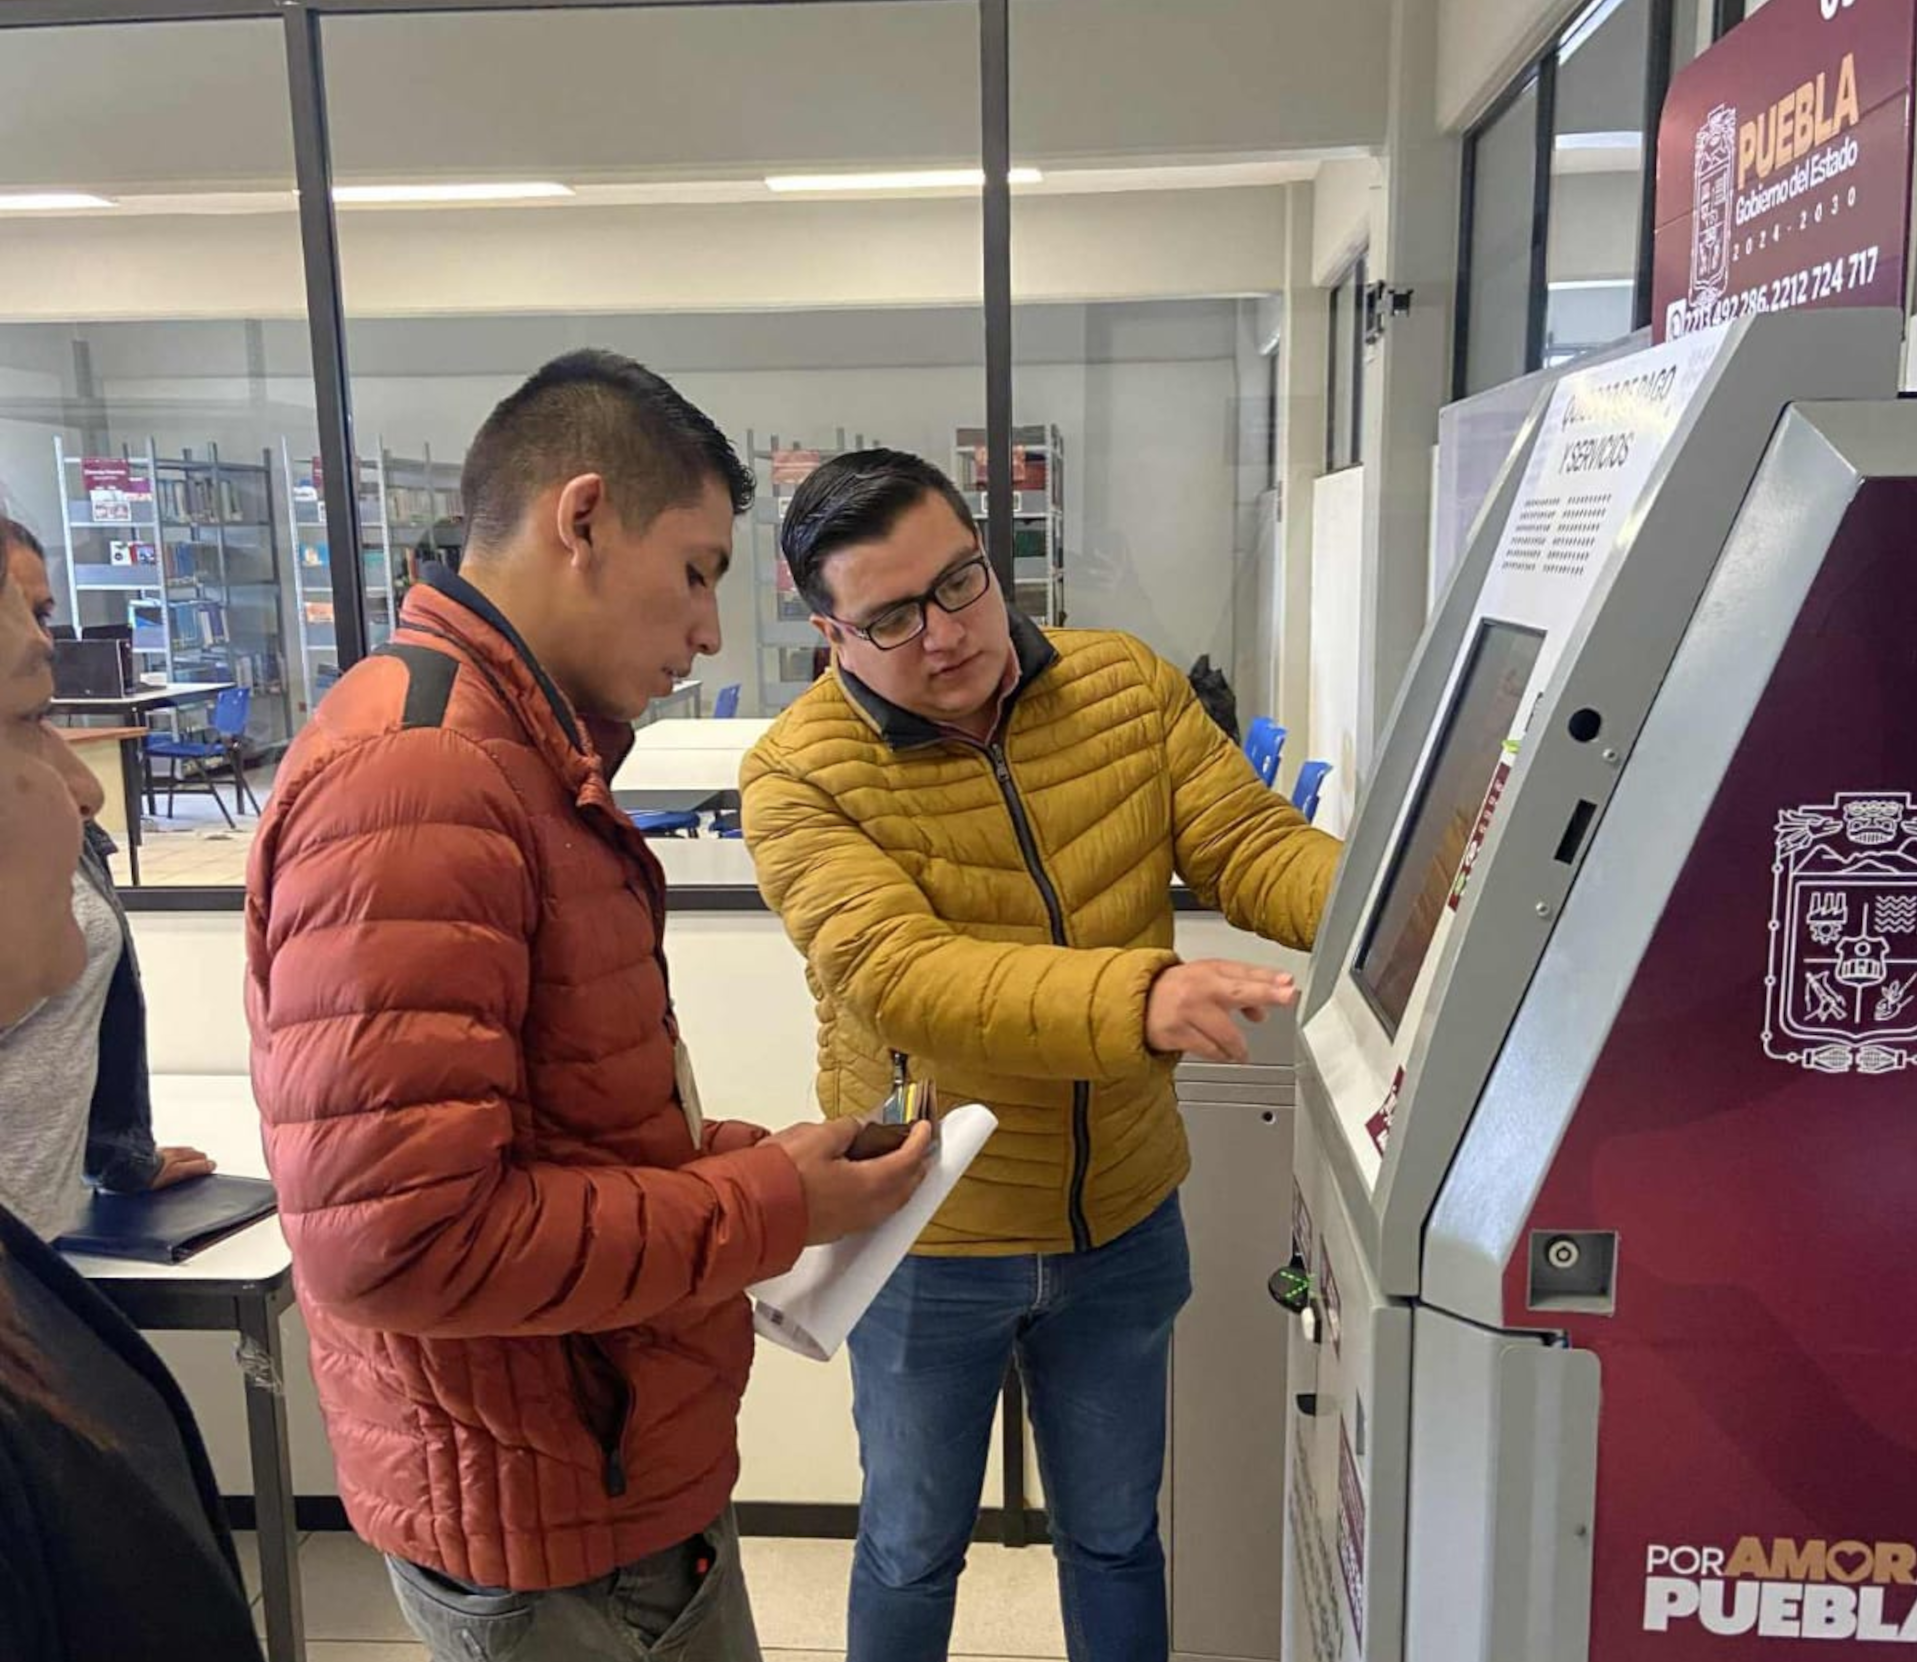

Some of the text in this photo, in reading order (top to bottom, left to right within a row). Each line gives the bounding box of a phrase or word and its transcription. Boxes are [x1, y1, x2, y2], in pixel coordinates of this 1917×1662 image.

[1738, 53, 1859, 190] PUEBLA
[1736, 136, 1858, 226] Gobierno del Estado
[1811, 257, 1844, 301] 724
[1848, 245, 1879, 289] 717
[1647, 1536, 1916, 1584] POR AMOR
